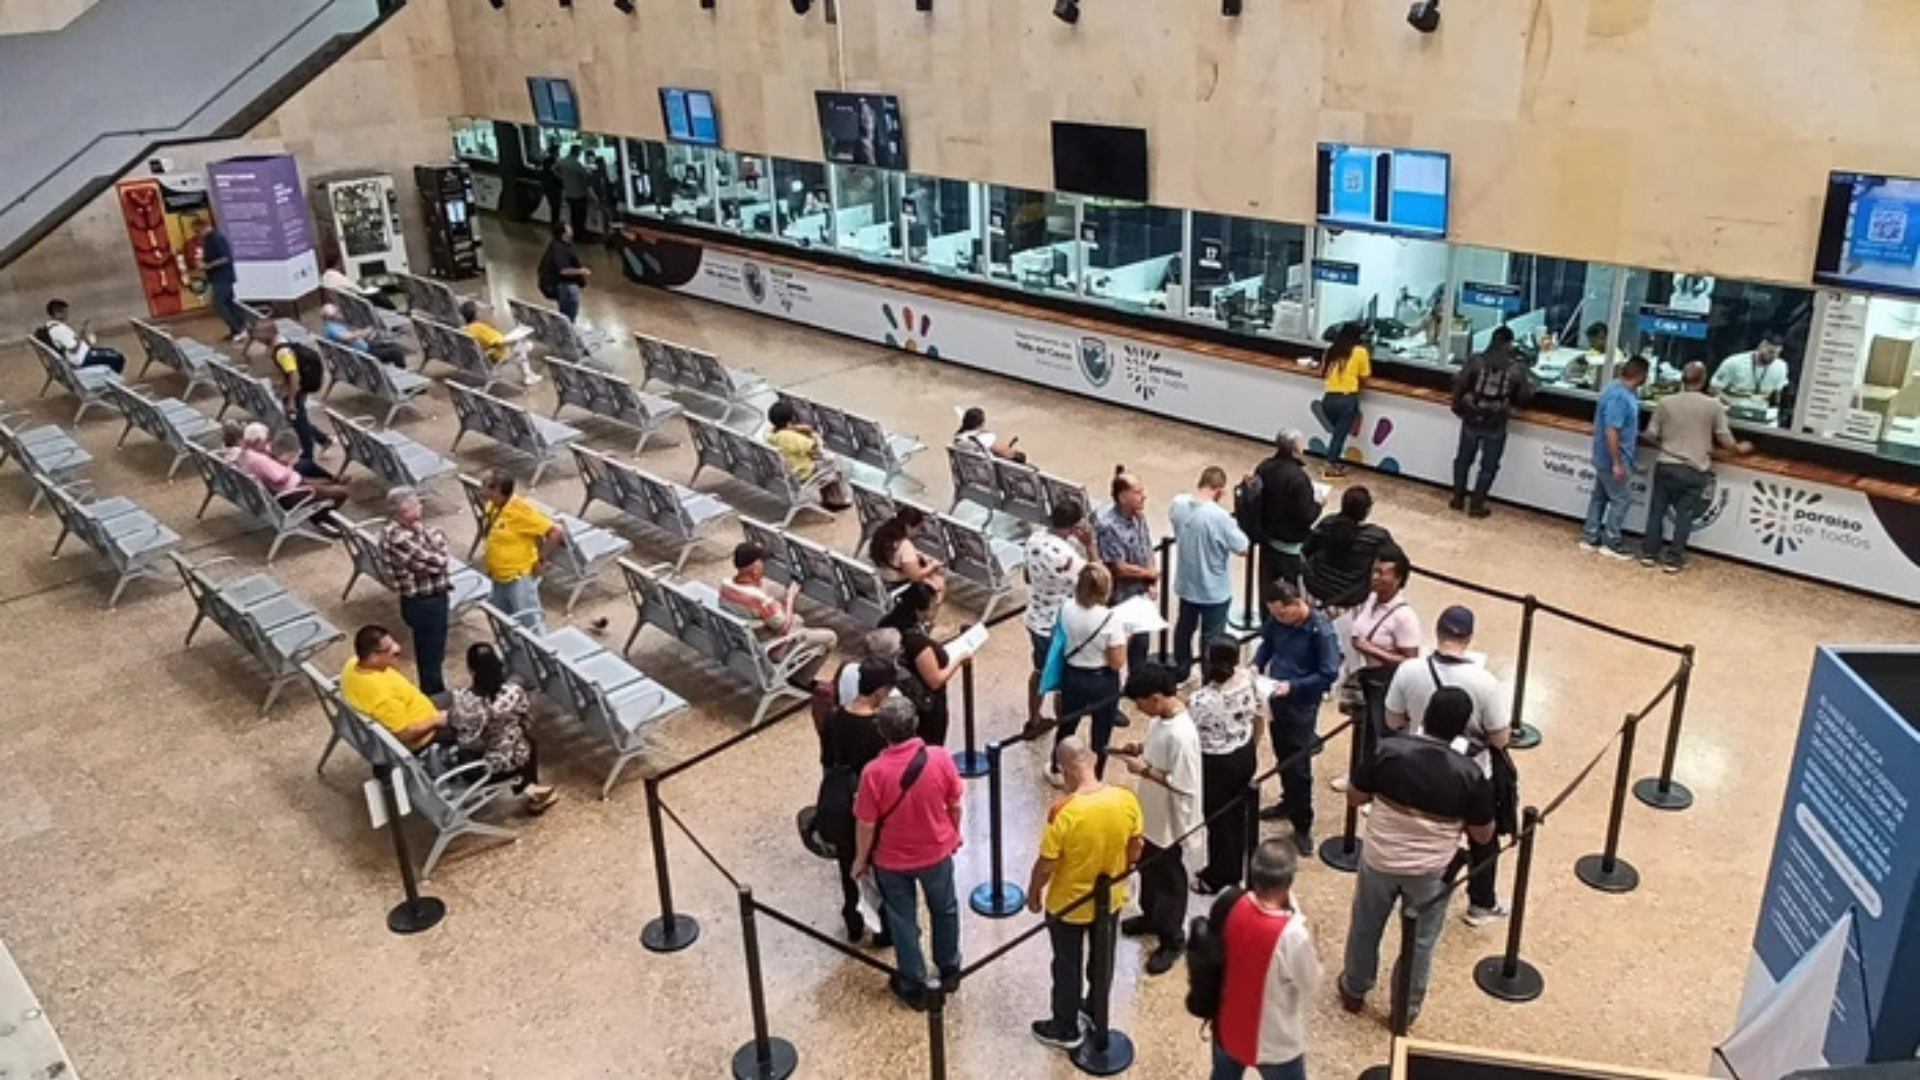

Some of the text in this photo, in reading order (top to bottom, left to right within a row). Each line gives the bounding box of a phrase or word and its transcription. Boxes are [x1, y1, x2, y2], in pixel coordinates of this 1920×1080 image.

[1543, 459, 1595, 481] Valle de
[1793, 522, 1872, 551] de todos
